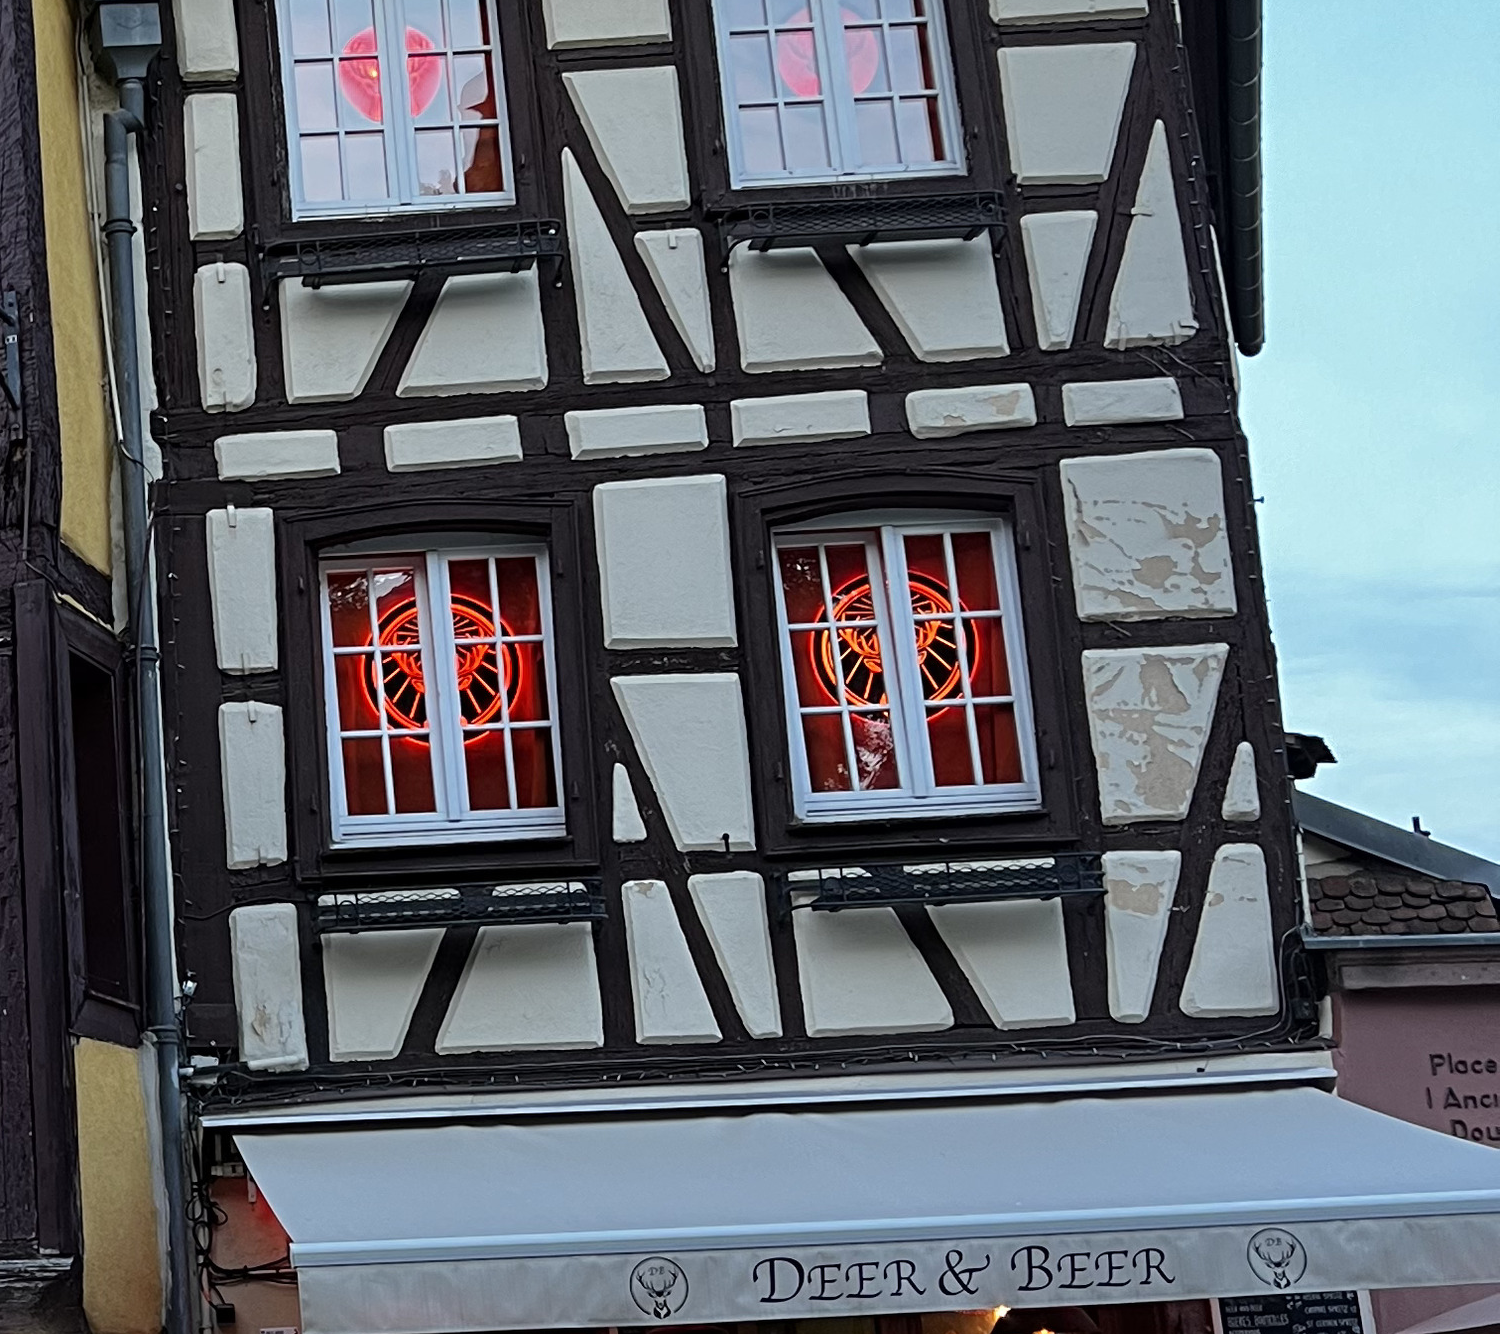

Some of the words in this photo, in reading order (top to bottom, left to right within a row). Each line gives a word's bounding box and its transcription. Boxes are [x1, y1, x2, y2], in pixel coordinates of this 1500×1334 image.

[1429, 1053, 1497, 1076] Place
[1444, 1087, 1499, 1110] Anci
[1450, 1119, 1500, 1141] Dou
[752, 1257, 927, 1303] DEER
[938, 1249, 990, 1296] &
[1011, 1245, 1176, 1291] BEER
